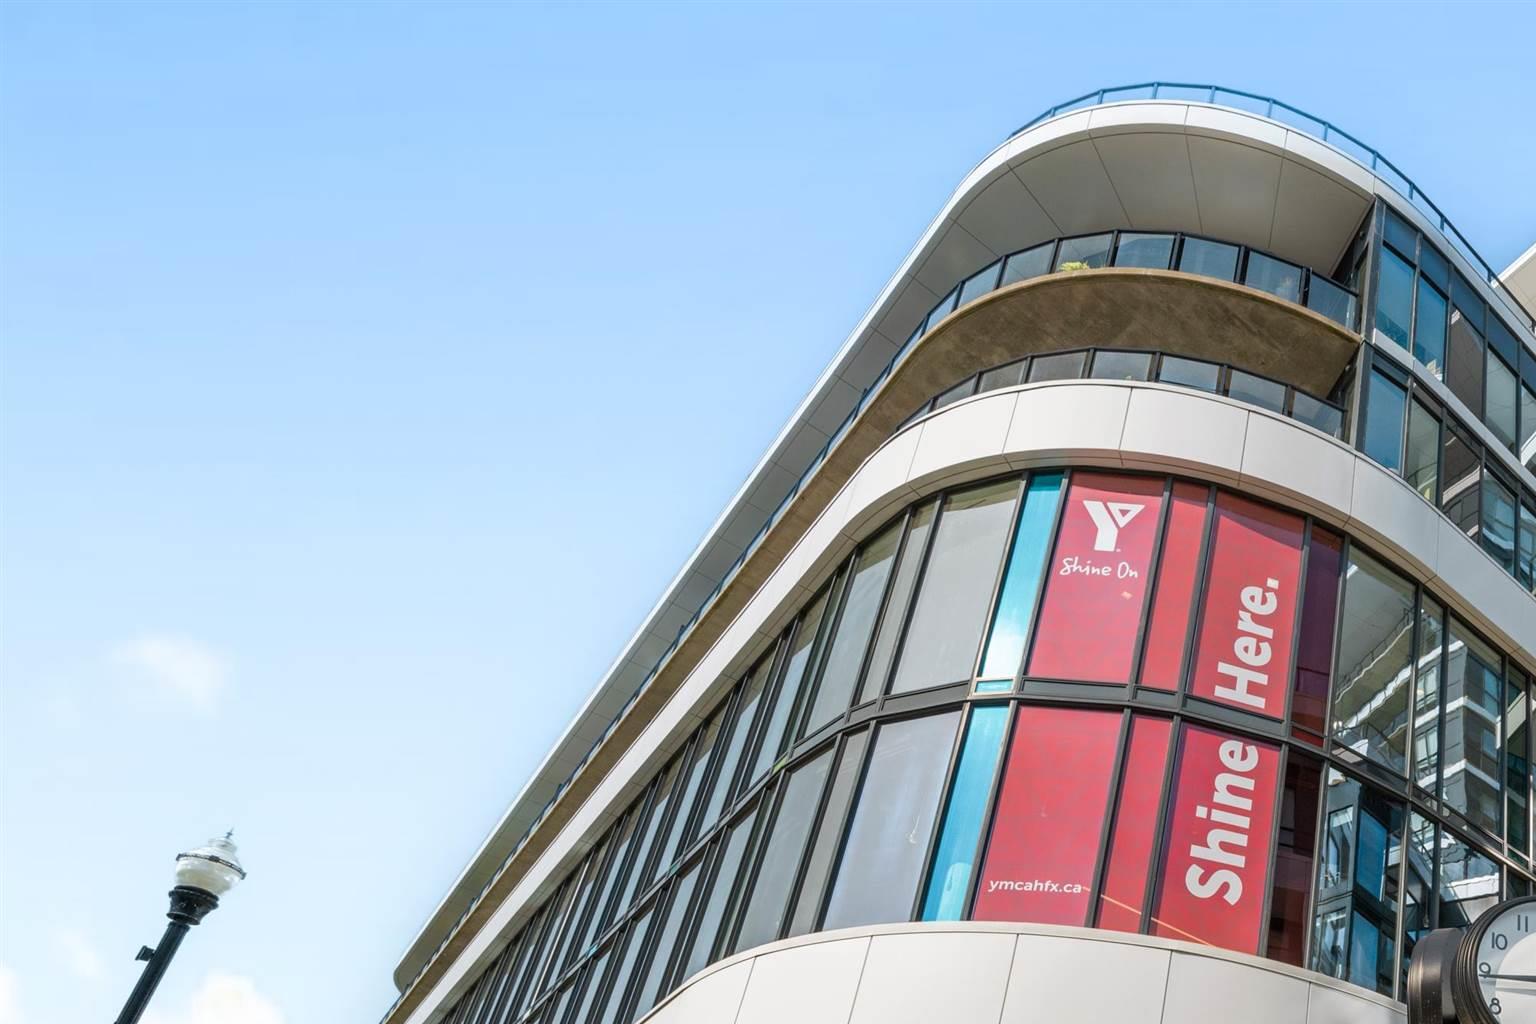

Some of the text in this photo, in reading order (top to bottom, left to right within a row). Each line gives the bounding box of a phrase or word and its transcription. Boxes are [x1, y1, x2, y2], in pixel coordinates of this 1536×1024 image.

[1059, 557, 1138, 579] Shine On
[1185, 577, 1280, 905] Shine Here.
[988, 880, 1082, 893] ymcahfx.ca
[1517, 914, 1528, 932] 11
[1491, 932, 1508, 950] 10
[1478, 962, 1491, 978] 9
[1488, 998, 1502, 1015] 8
